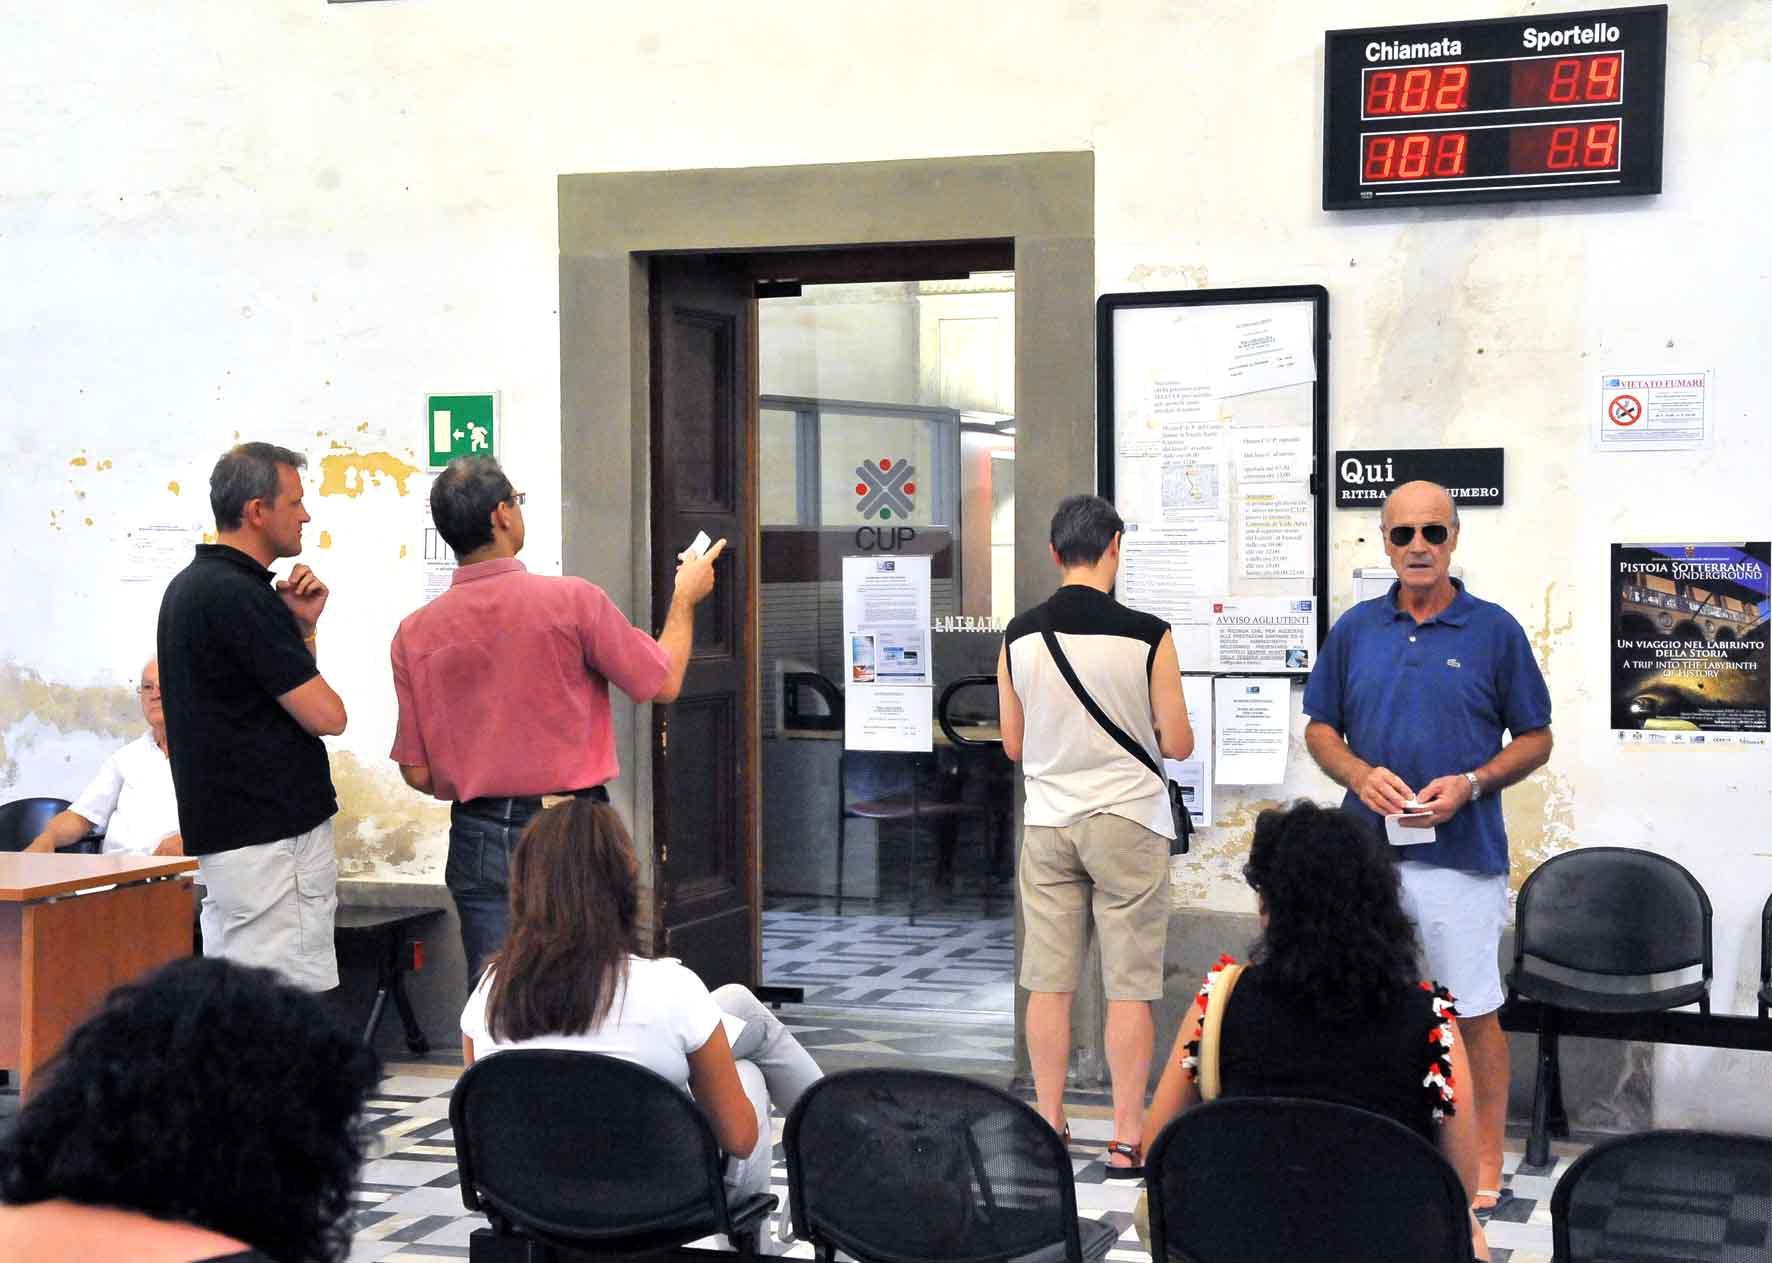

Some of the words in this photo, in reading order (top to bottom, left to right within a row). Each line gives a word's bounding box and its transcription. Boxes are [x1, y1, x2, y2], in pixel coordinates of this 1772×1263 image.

[1365, 38, 1462, 62] Chiamata
[1523, 23, 1620, 51] Sportello
[1382, 66, 1468, 111] 102
[1382, 133, 1465, 178] 101
[1620, 380, 1662, 389] VIETATO
[1664, 378, 1705, 388] FUMARE
[1341, 457, 1395, 485] Qui
[1341, 489, 1387, 499] RITIRA
[855, 525, 915, 551] CUP
[1619, 562, 1668, 573] PISTOIA
[1672, 561, 1761, 573] SOTTERRANEA
[1673, 571, 1763, 580] UNDERGROUND
[935, 616, 1003, 633] ENTRATA
[1216, 616, 1250, 625] AVVISO
[1252, 616, 1274, 625] AGLI
[1276, 615, 1309, 625] UTENTI
[1616, 640, 1633, 649] UN
[1636, 640, 1681, 649] VIAGGIO
[1684, 640, 1704, 649] NEL
[1707, 640, 1765, 649] LABIRINTO
[1655, 649, 1687, 658] DELLA
[1689, 649, 1728, 658] STORIA
[1623, 660, 1630, 669] A
[1632, 661, 1654, 669] TRIP
[1655, 661, 1679, 670] INTO
[1681, 661, 1702, 670] THE
[1704, 661, 1758, 670] LABYRINTH
[1663, 669, 1676, 679] OF
[1678, 669, 1720, 679] HISTORY
